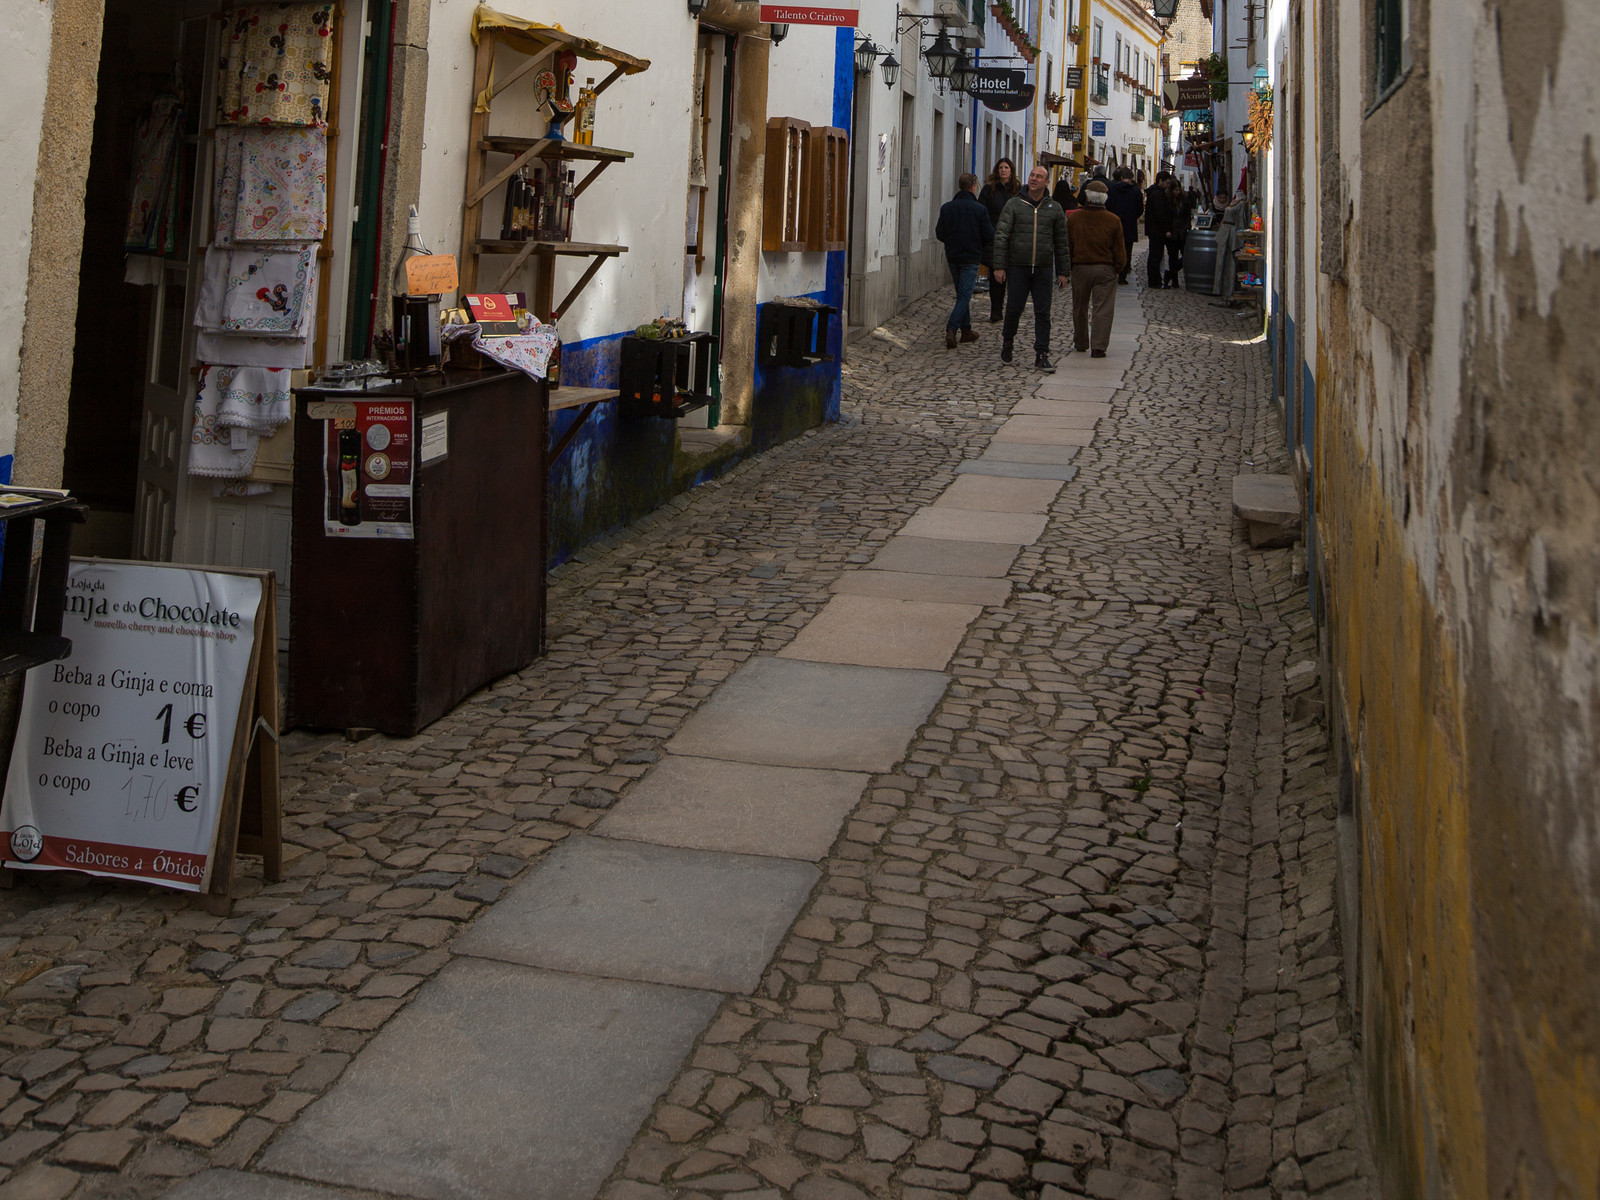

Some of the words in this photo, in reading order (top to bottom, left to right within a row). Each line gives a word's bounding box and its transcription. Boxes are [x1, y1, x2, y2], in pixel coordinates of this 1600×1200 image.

[774, 9, 807, 20] Talento
[809, 11, 846, 22] Criativo
[980, 77, 1010, 89] Hotel
[369, 406, 405, 415] PRÉMIOS
[71, 578, 91, 590] Loja
[94, 579, 105, 590] da
[64, 587, 108, 621] inja
[113, 603, 119, 612] e
[123, 601, 136, 613] do
[139, 597, 240, 627] Chocolate
[94, 620, 127, 630] morello
[128, 621, 155, 634] cherry
[158, 625, 173, 634] and
[176, 626, 214, 639] chocolate
[216, 628, 237, 643] shop
[53, 664, 92, 686] Beba
[97, 674, 105, 687] a
[111, 669, 155, 696] Ginja
[159, 679, 168, 693] e
[173, 681, 213, 698] coma
[48, 700, 58, 714] o
[63, 701, 101, 722] copo
[155, 703, 173, 744] 1
[183, 713, 207, 739] €
[43, 736, 82, 759] Beba
[87, 747, 96, 760] a
[101, 742, 145, 770] Ginja
[150, 753, 159, 767] e
[163, 749, 194, 771] leve
[39, 773, 48, 787] o
[53, 774, 90, 795] copo
[174, 785, 200, 812] €
[13, 834, 41, 851] Loja
[66, 844, 129, 868] Sabores
[134, 858, 143, 870] a
